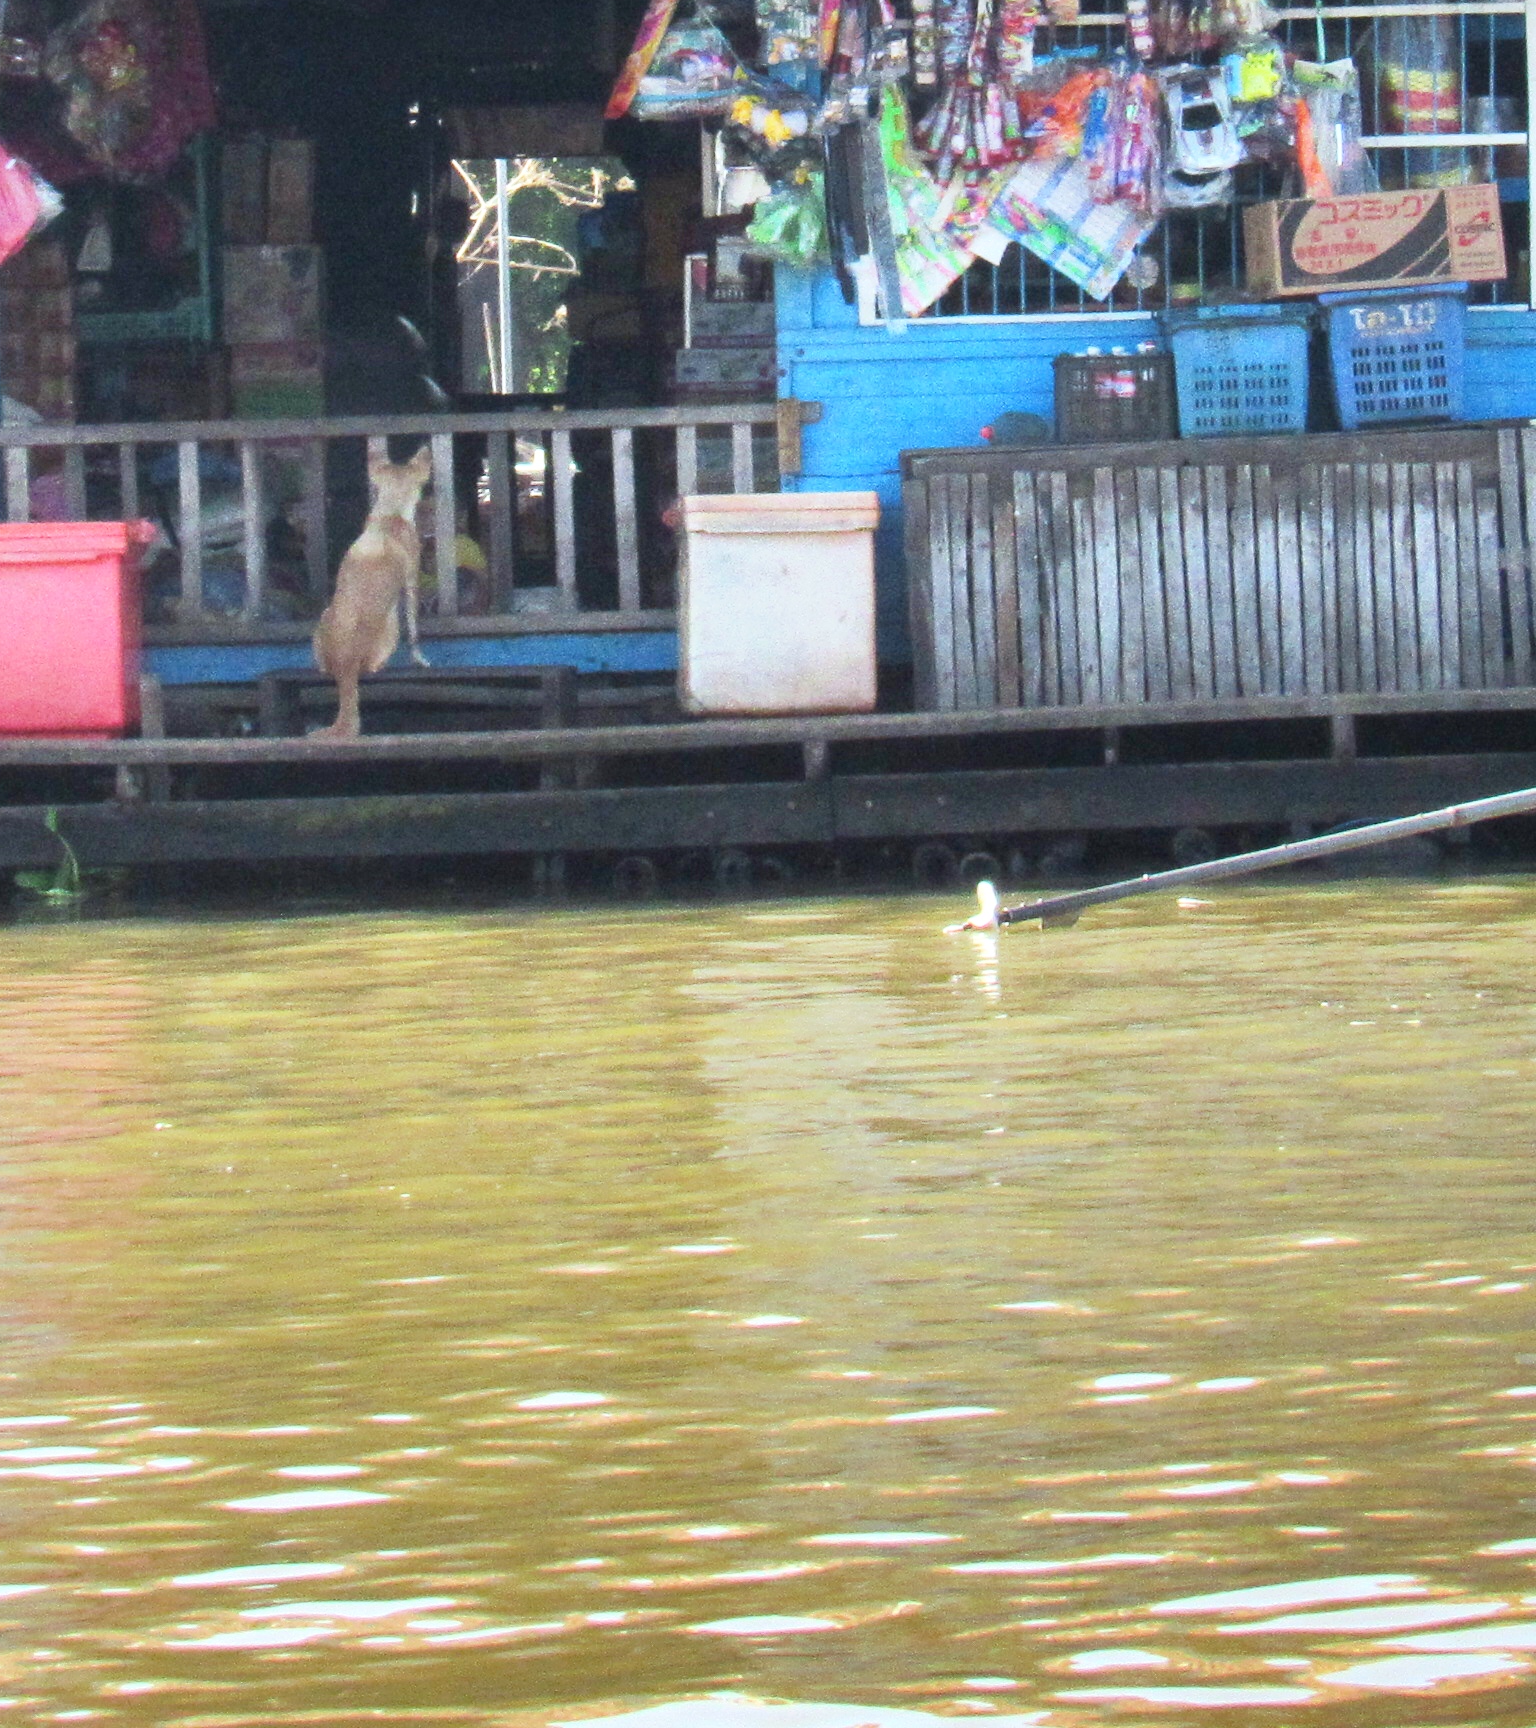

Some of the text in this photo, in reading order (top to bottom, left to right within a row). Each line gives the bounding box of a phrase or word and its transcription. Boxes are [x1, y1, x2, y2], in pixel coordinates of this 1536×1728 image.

[1317, 195, 1422, 225] コスミック
